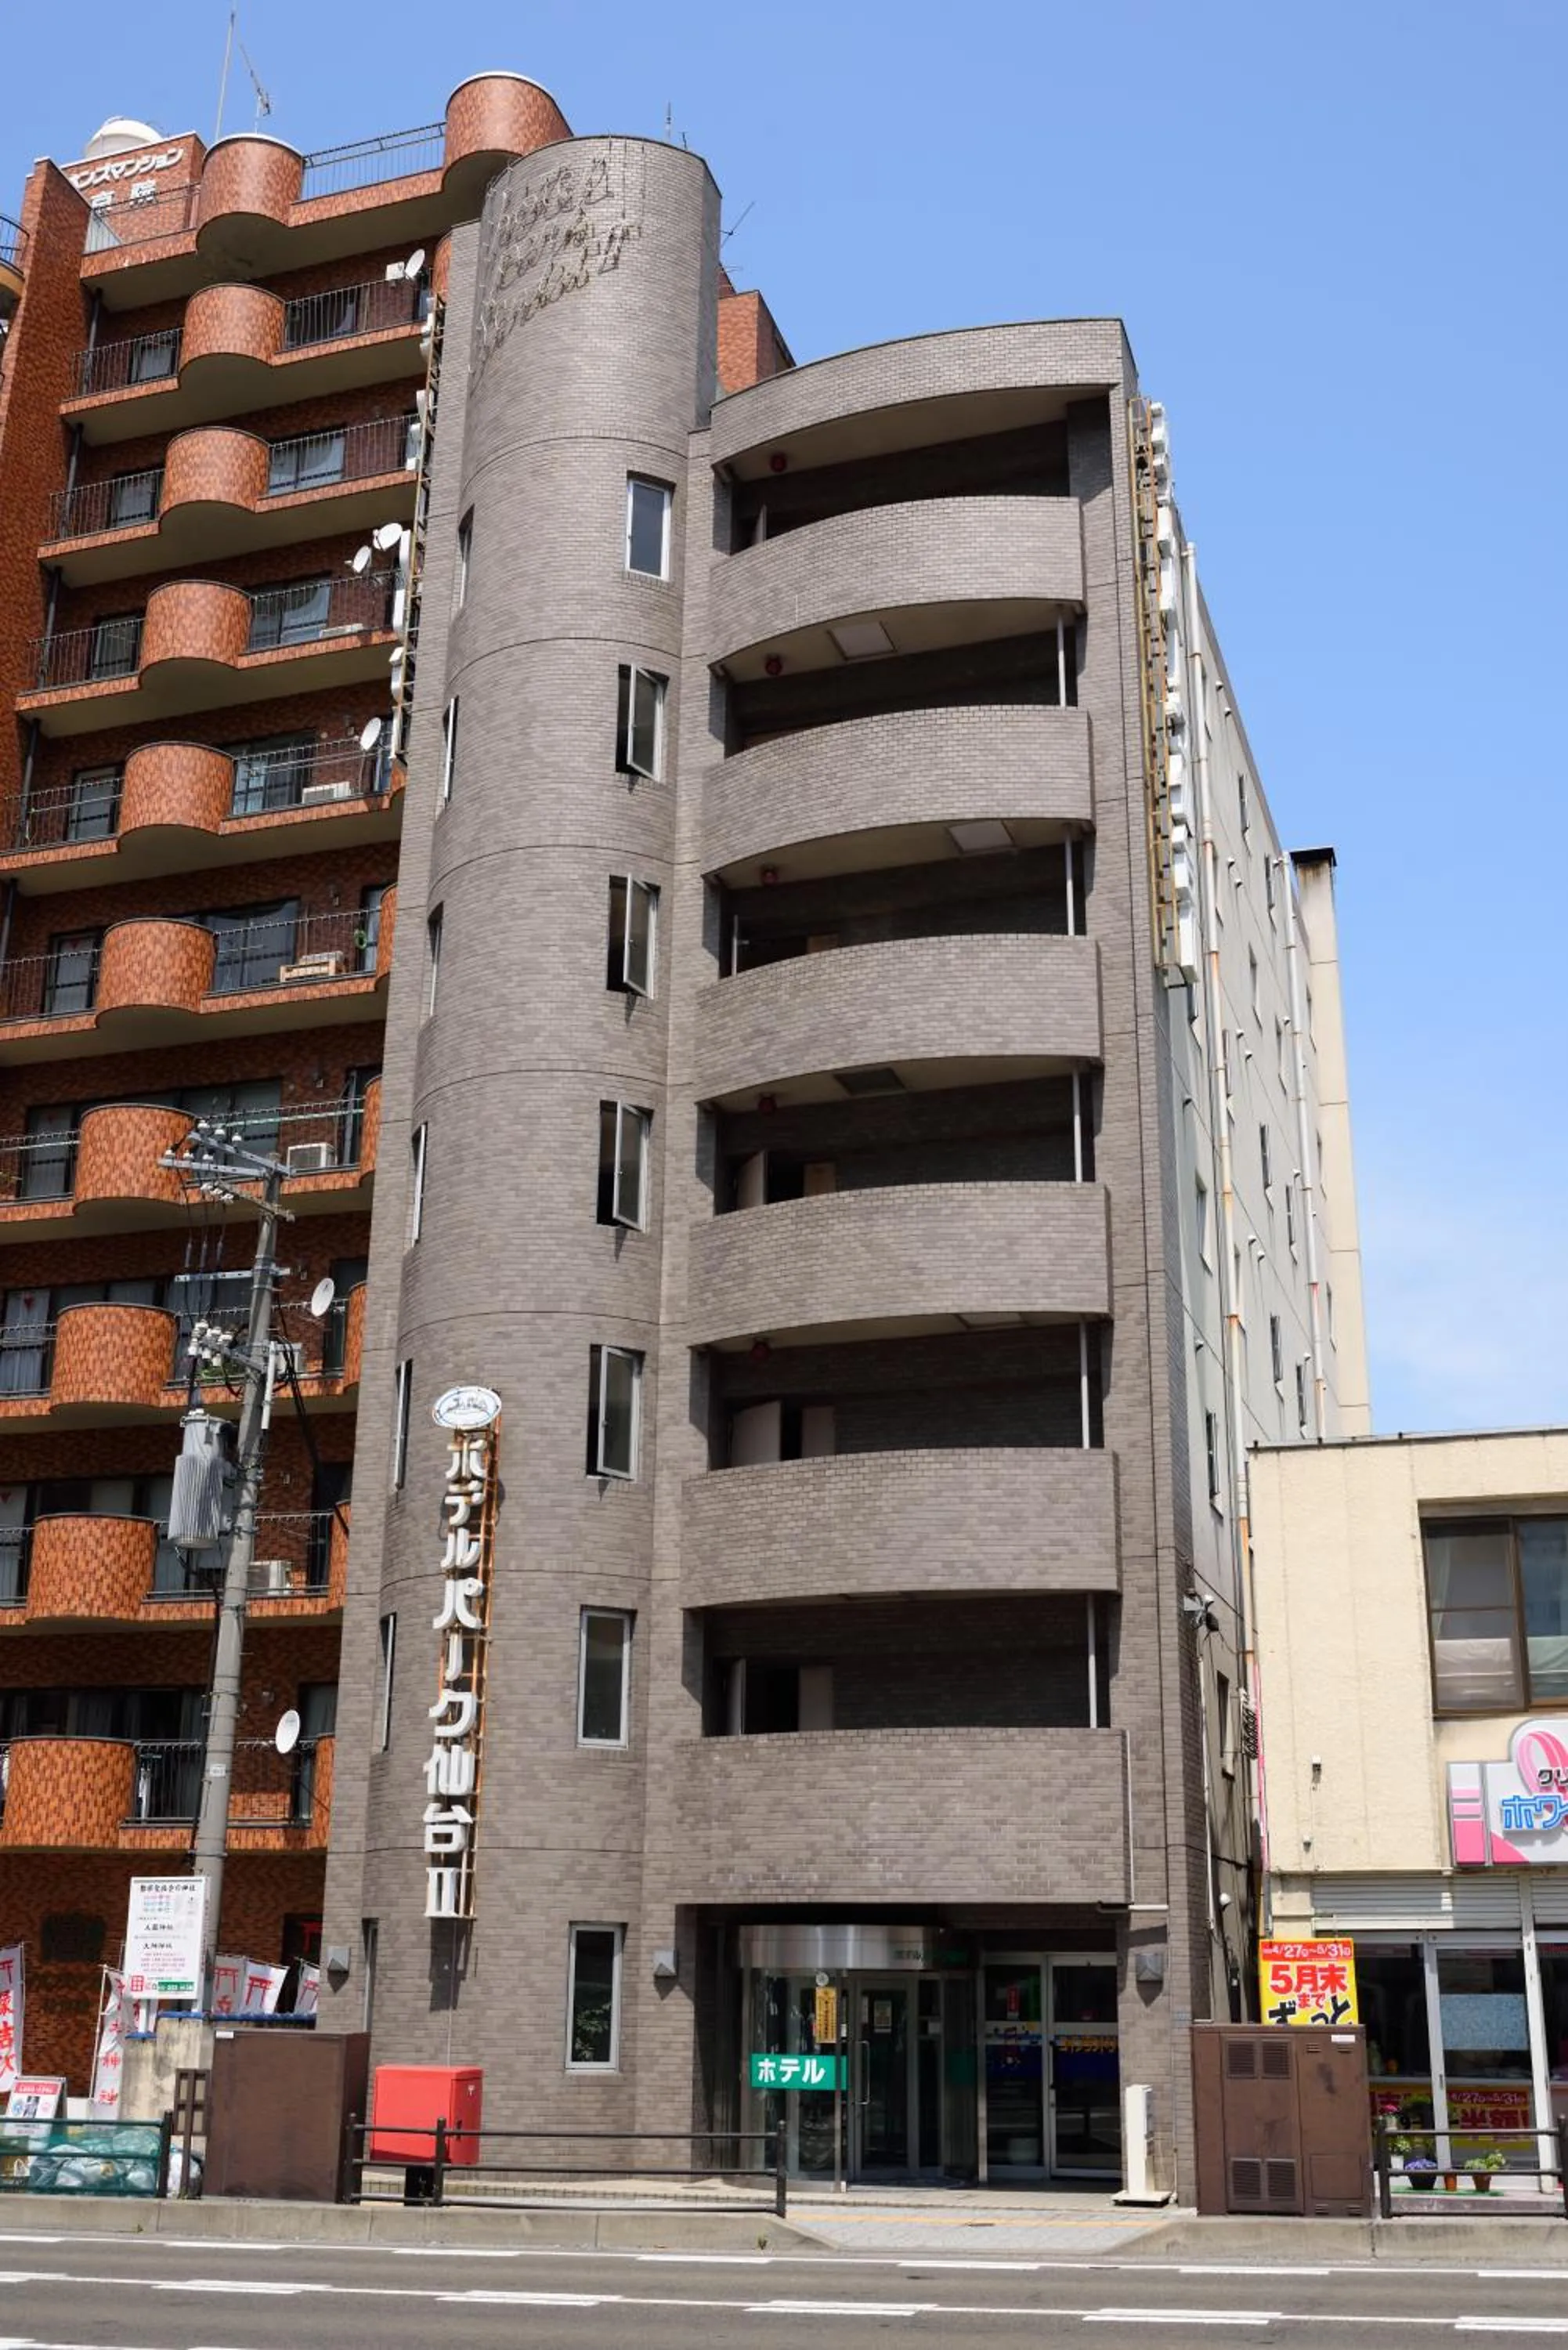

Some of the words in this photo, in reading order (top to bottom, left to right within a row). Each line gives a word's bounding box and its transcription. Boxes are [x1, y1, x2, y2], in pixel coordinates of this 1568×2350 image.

[1270, 1963, 1348, 1994] 5月末
[1297, 1993, 1326, 2008] まで
[757, 2058, 826, 2084] ホテル
